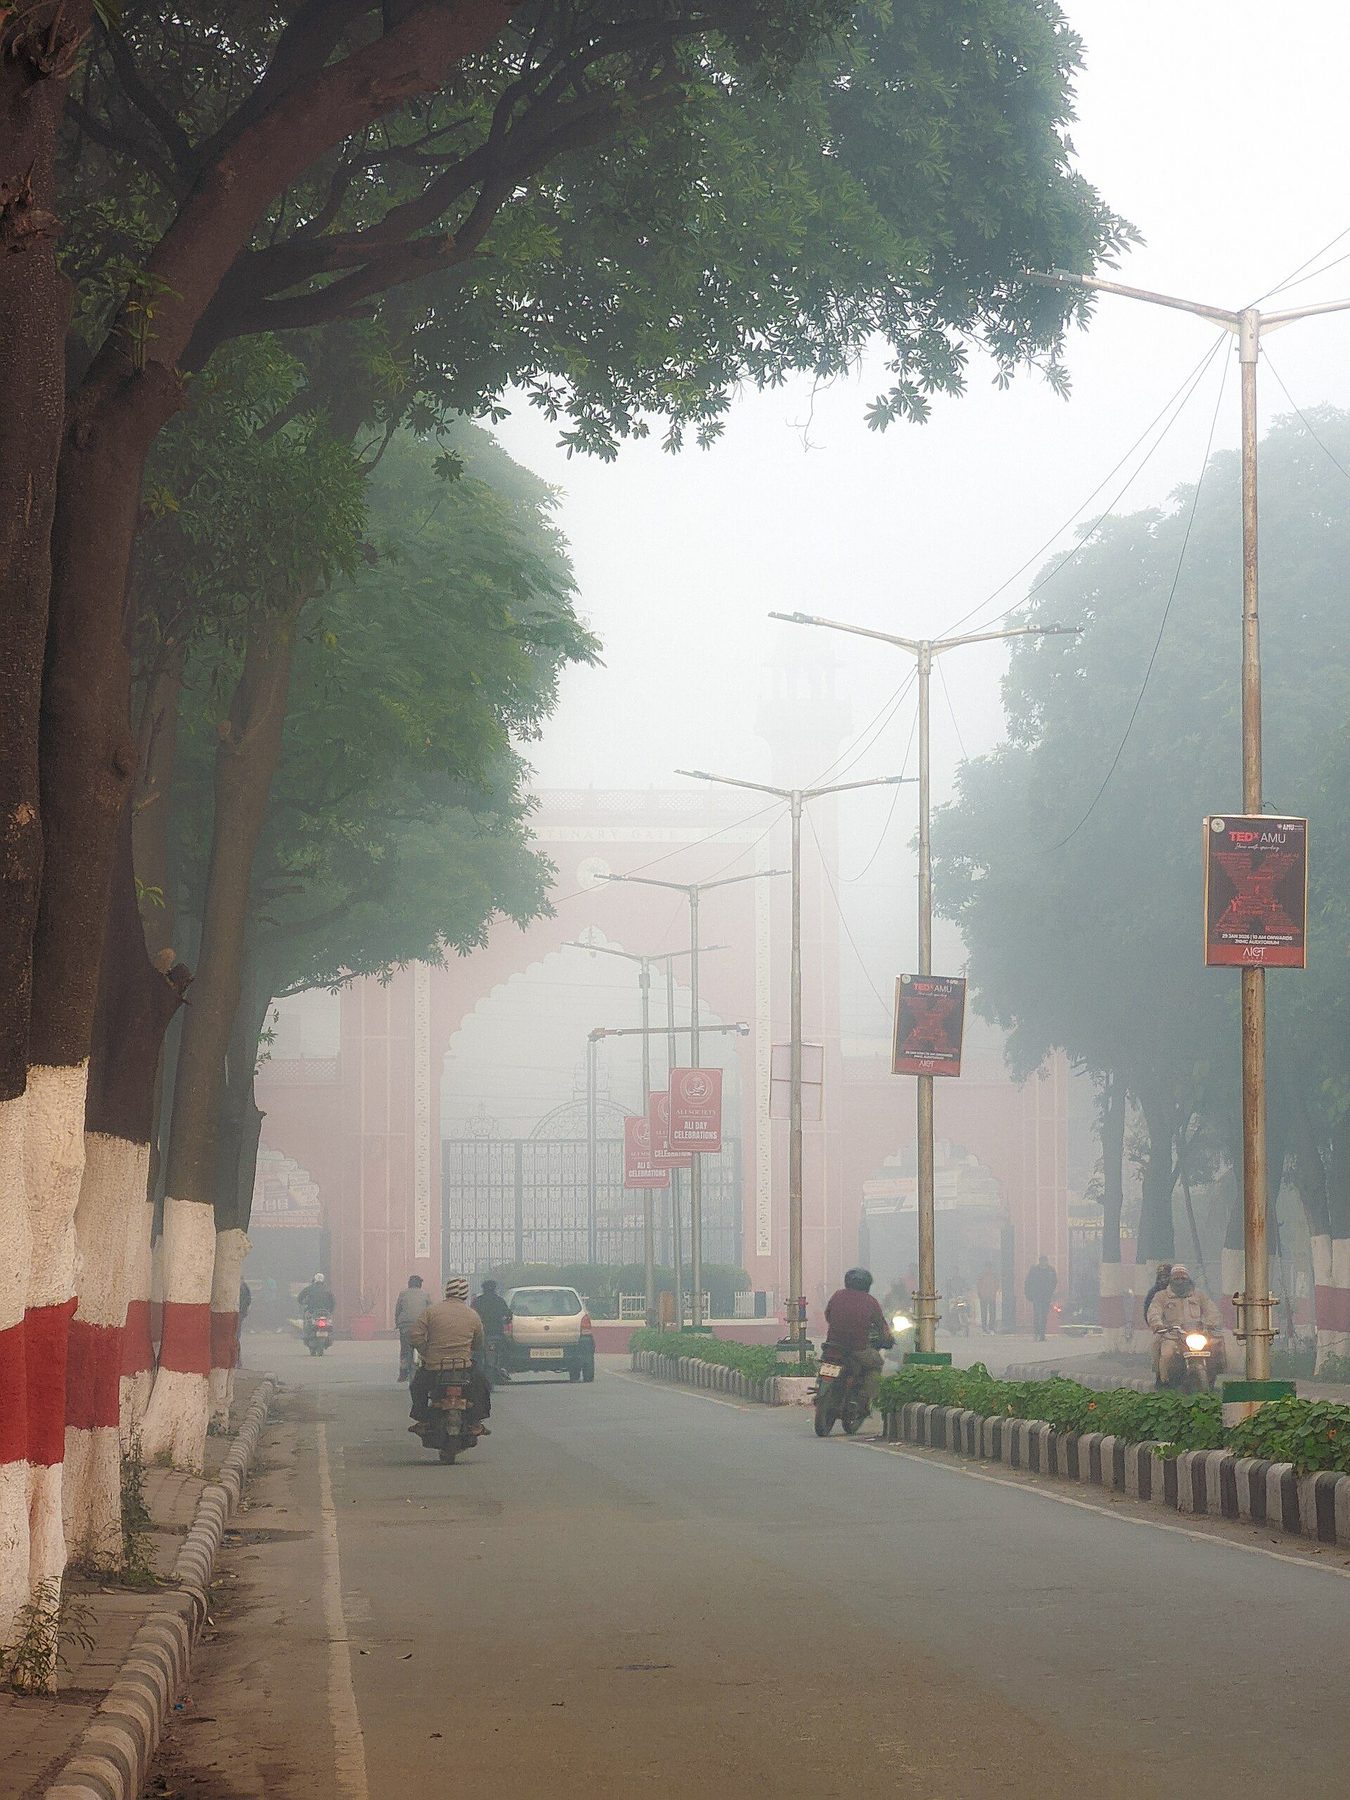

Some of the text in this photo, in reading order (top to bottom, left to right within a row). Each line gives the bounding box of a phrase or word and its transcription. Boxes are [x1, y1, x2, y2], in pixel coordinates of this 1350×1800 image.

[684, 1121, 708, 1130] ALI DAY
[674, 1130, 718, 1140] CELEBRATIONS
